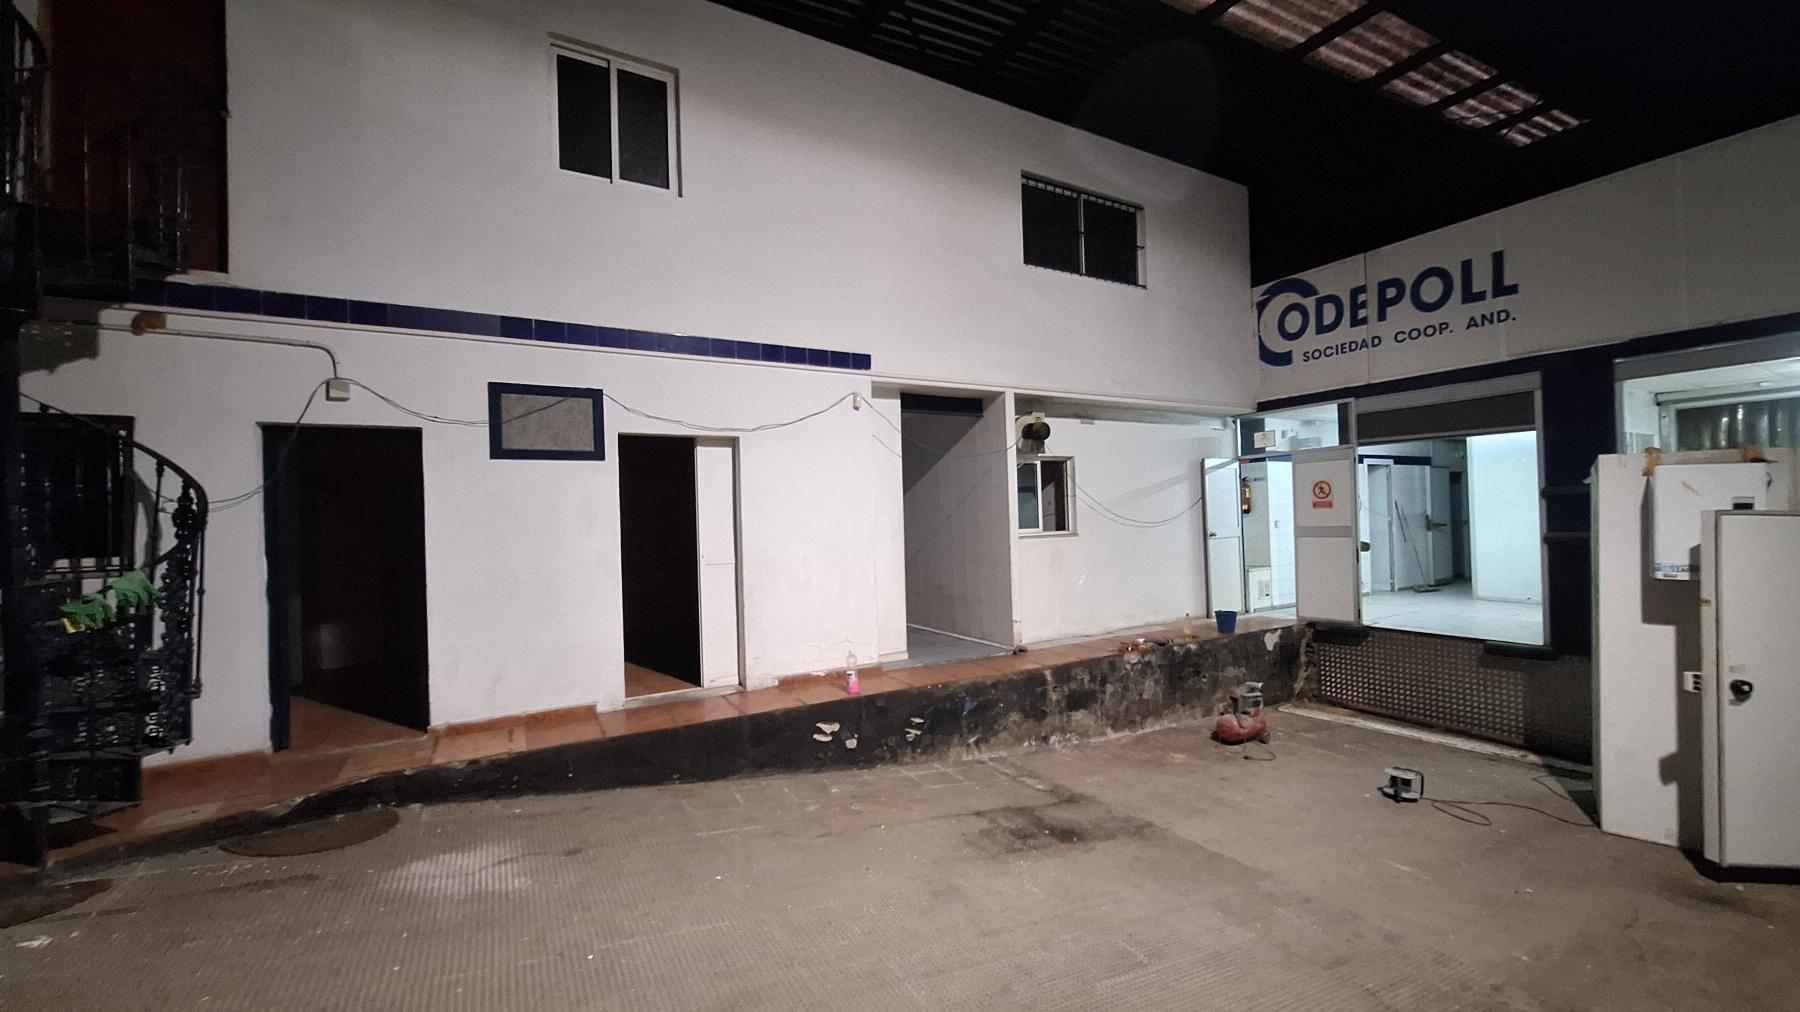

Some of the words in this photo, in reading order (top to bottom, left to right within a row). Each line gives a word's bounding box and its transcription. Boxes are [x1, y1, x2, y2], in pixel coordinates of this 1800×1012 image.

[1256, 250, 1519, 367] CODEPOLL
[1303, 335, 1382, 362] SOCIEDAD
[1394, 322, 1454, 344] COOP.
[1465, 309, 1517, 330] AND.
